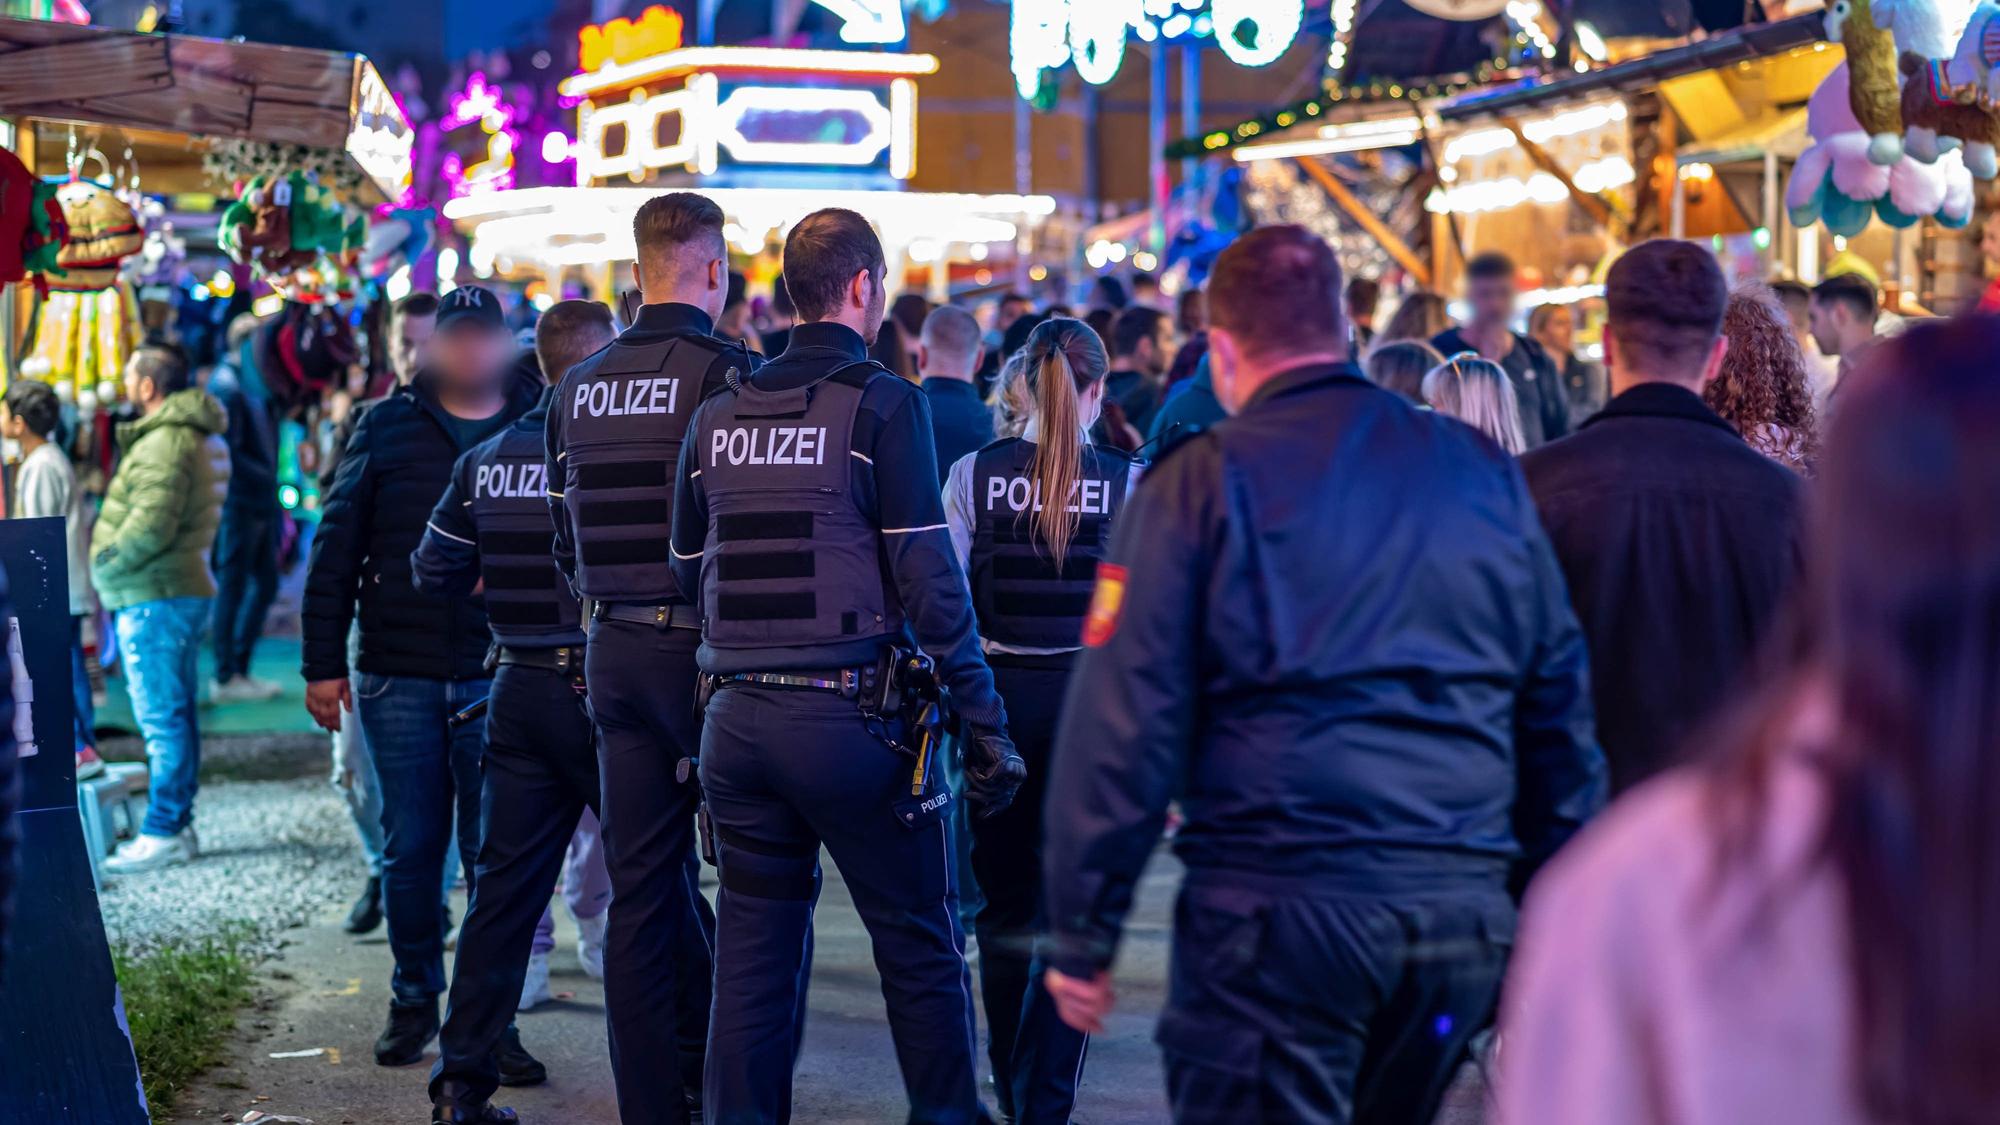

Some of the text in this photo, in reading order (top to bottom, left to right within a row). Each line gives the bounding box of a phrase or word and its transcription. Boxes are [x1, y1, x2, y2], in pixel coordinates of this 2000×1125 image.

[573, 378, 680, 419] POLIZEI
[711, 427, 827, 467] POLIZEI
[475, 463, 549, 499] POLIZE
[987, 476, 1110, 514] POLZEI
[920, 792, 948, 814] POLIZEI
